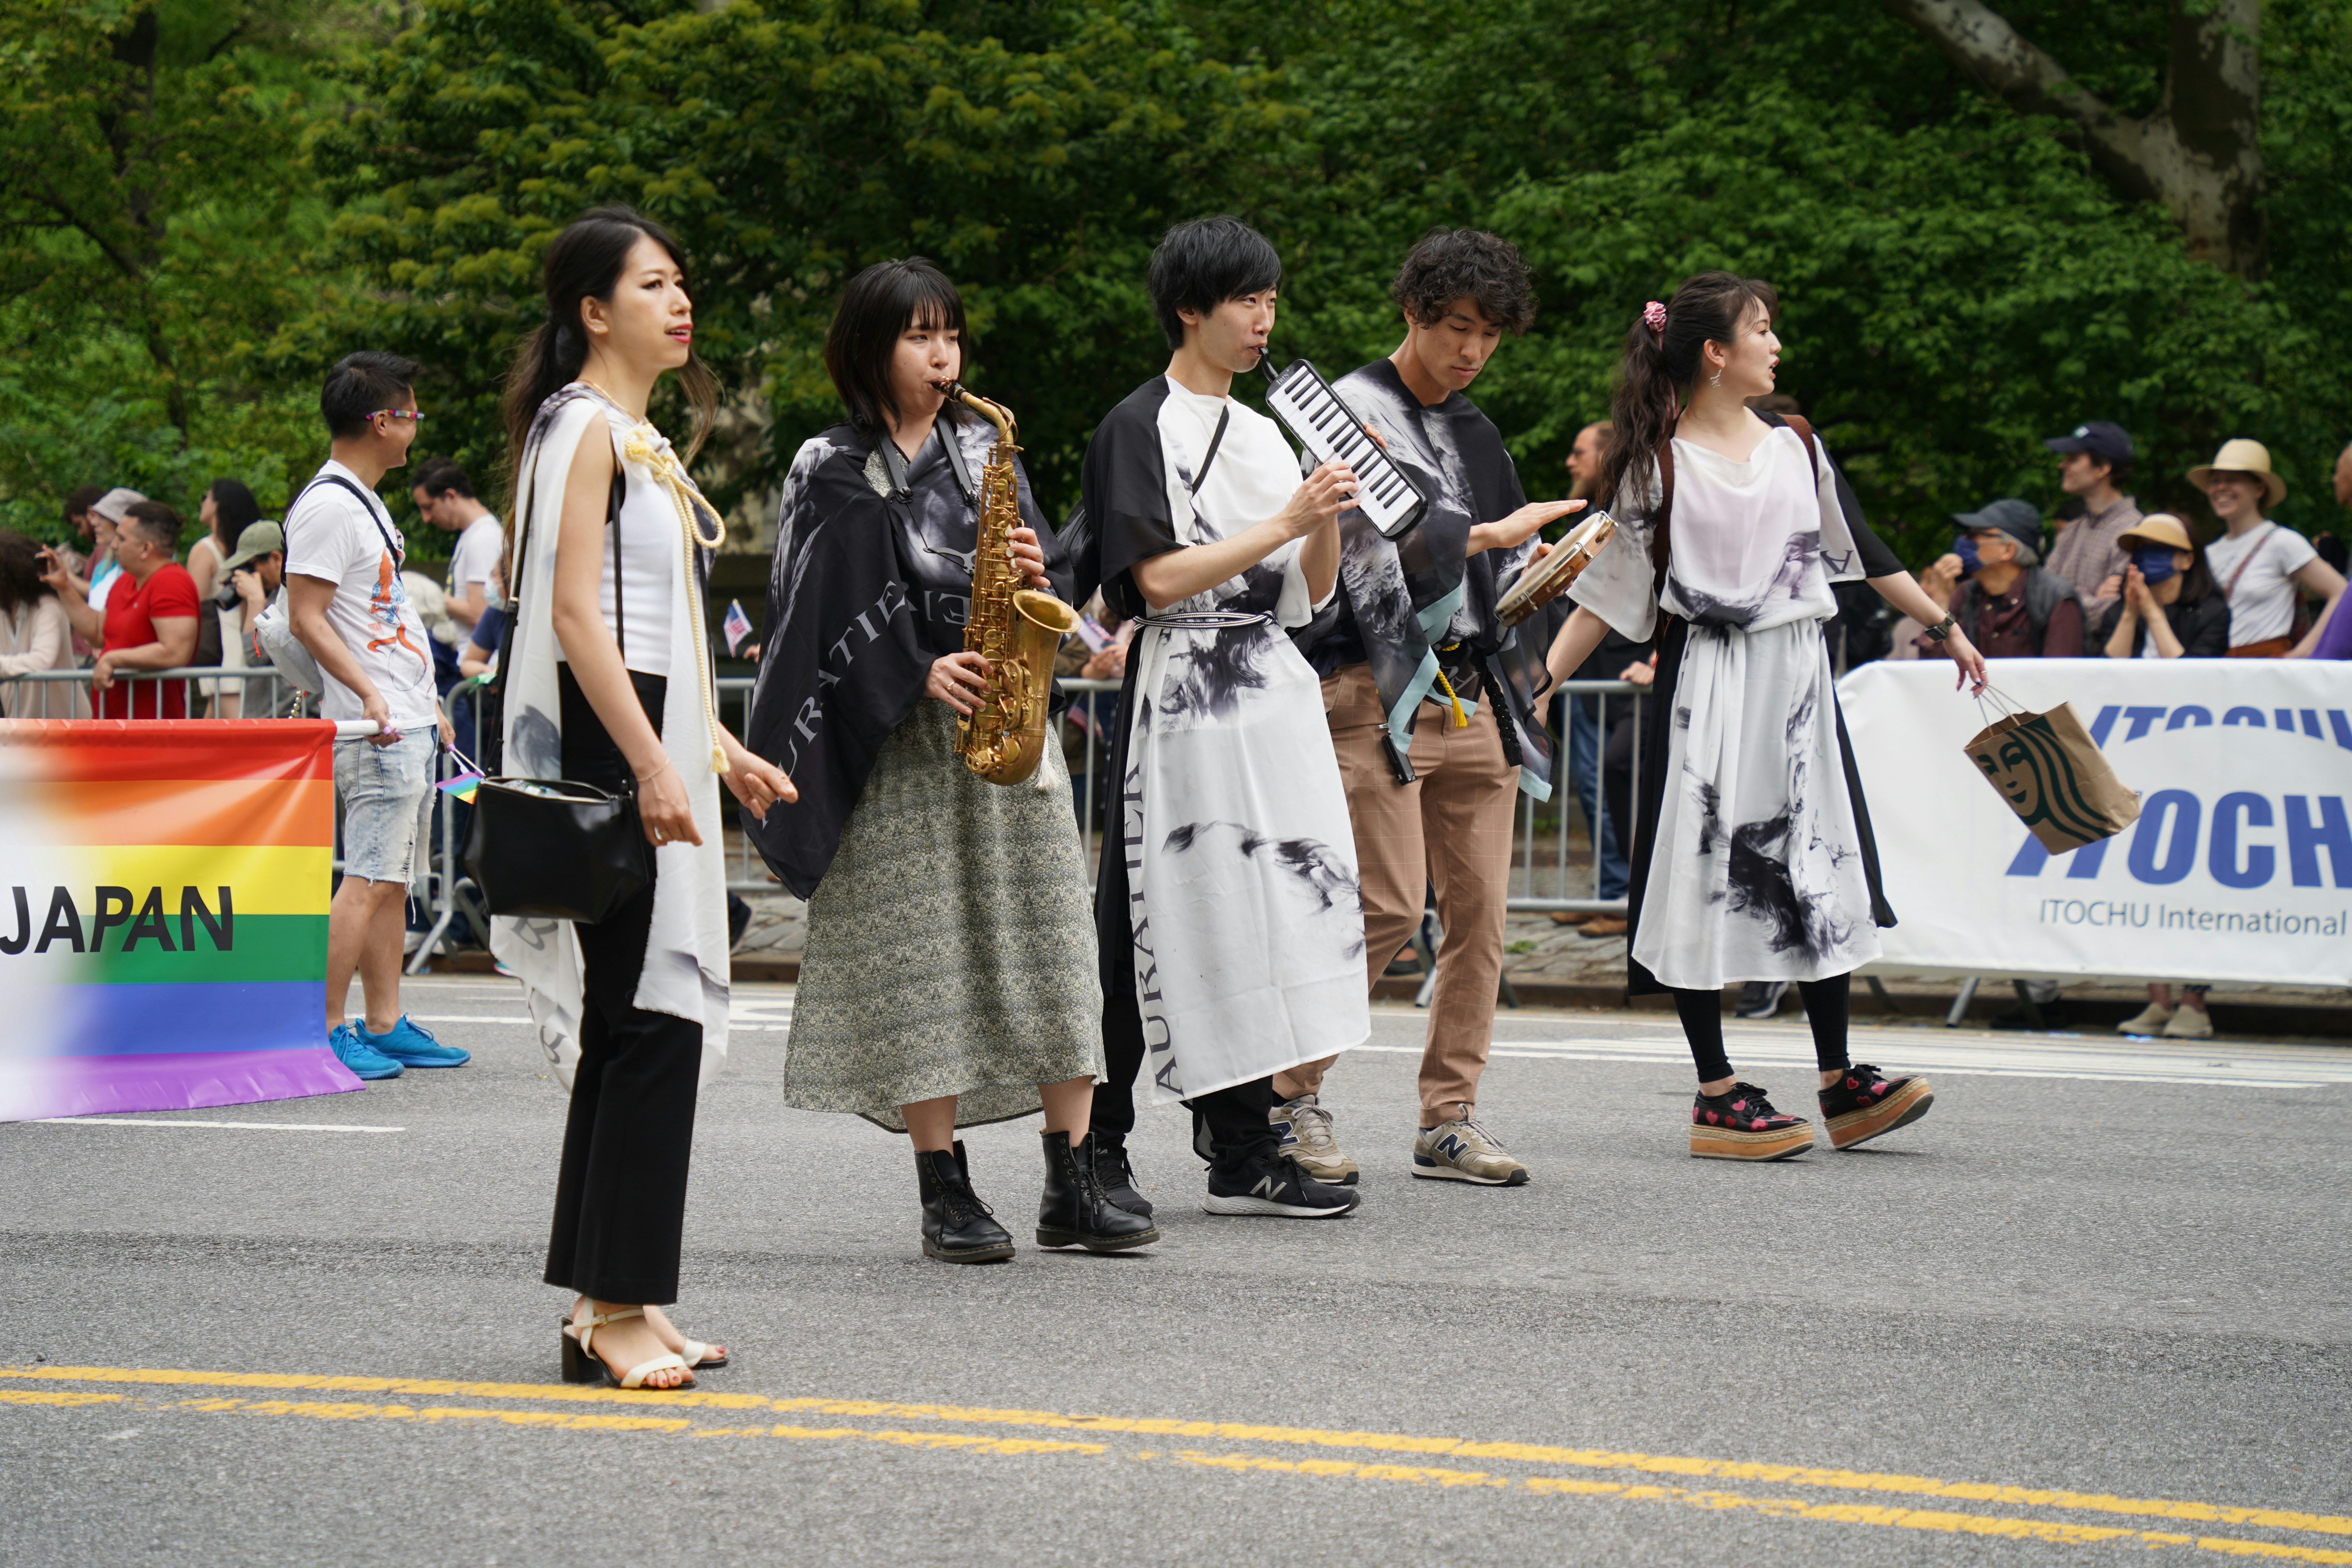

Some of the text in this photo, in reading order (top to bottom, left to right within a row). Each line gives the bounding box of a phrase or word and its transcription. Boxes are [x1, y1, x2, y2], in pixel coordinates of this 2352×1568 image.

[0, 886, 233, 955] JAPAN
[2039, 898, 2347, 936] ITOCHU International
